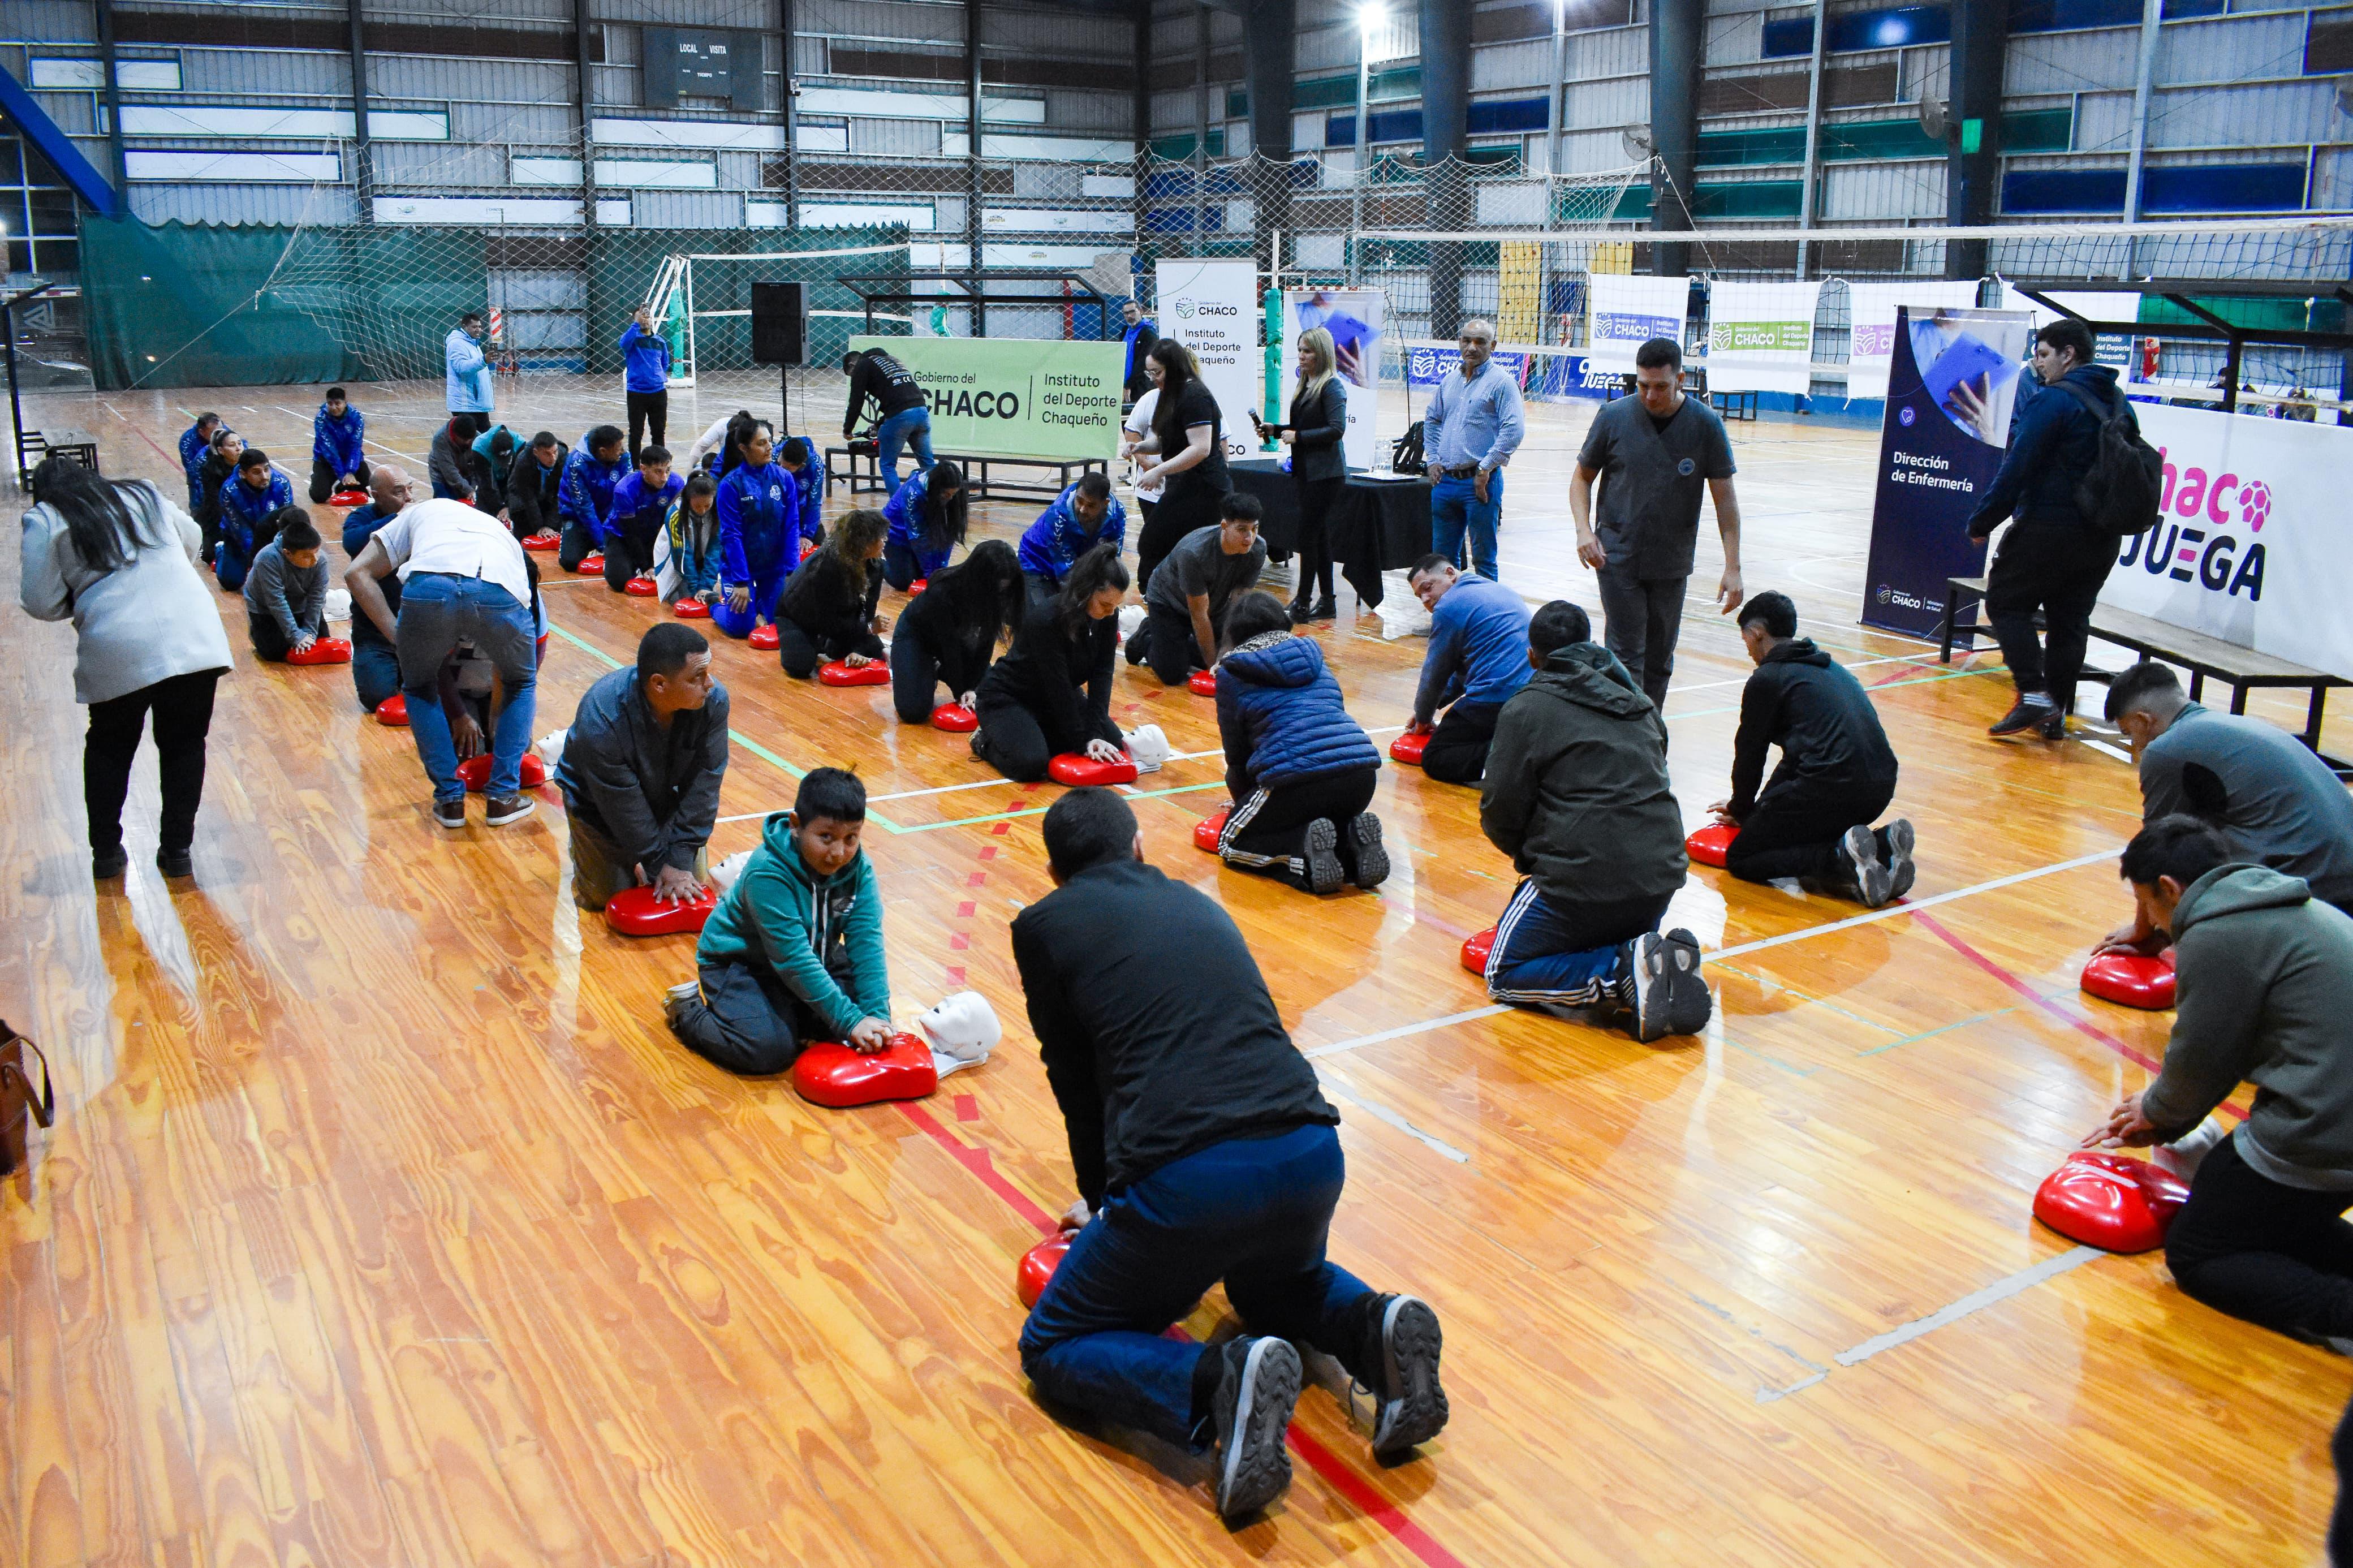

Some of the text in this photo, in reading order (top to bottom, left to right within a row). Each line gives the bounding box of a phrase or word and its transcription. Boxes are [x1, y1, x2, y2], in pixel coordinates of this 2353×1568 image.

[679, 44, 727, 54] LOCAL VISITA
[1199, 307, 1237, 316] CHACO
[1186, 329, 1225, 338] Instituto
[1615, 324, 1649, 337] CHACO
[1735, 333, 1775, 345] CHACO
[1203, 342, 1241, 352] Deporte
[1200, 356, 1235, 365] aqueño
[914, 371, 958, 384] Gobierno
[961, 373, 976, 384] del
[1045, 373, 1100, 387] Instituto
[1044, 393, 1117, 410] del Deporte
[1042, 411, 1107, 428] Chaqueño
[1893, 451, 1949, 469] Dirección
[1891, 469, 1973, 492] de Enfermería
[2119, 515, 2265, 602] JUEGA
[1892, 595, 1921, 608] CHACO
